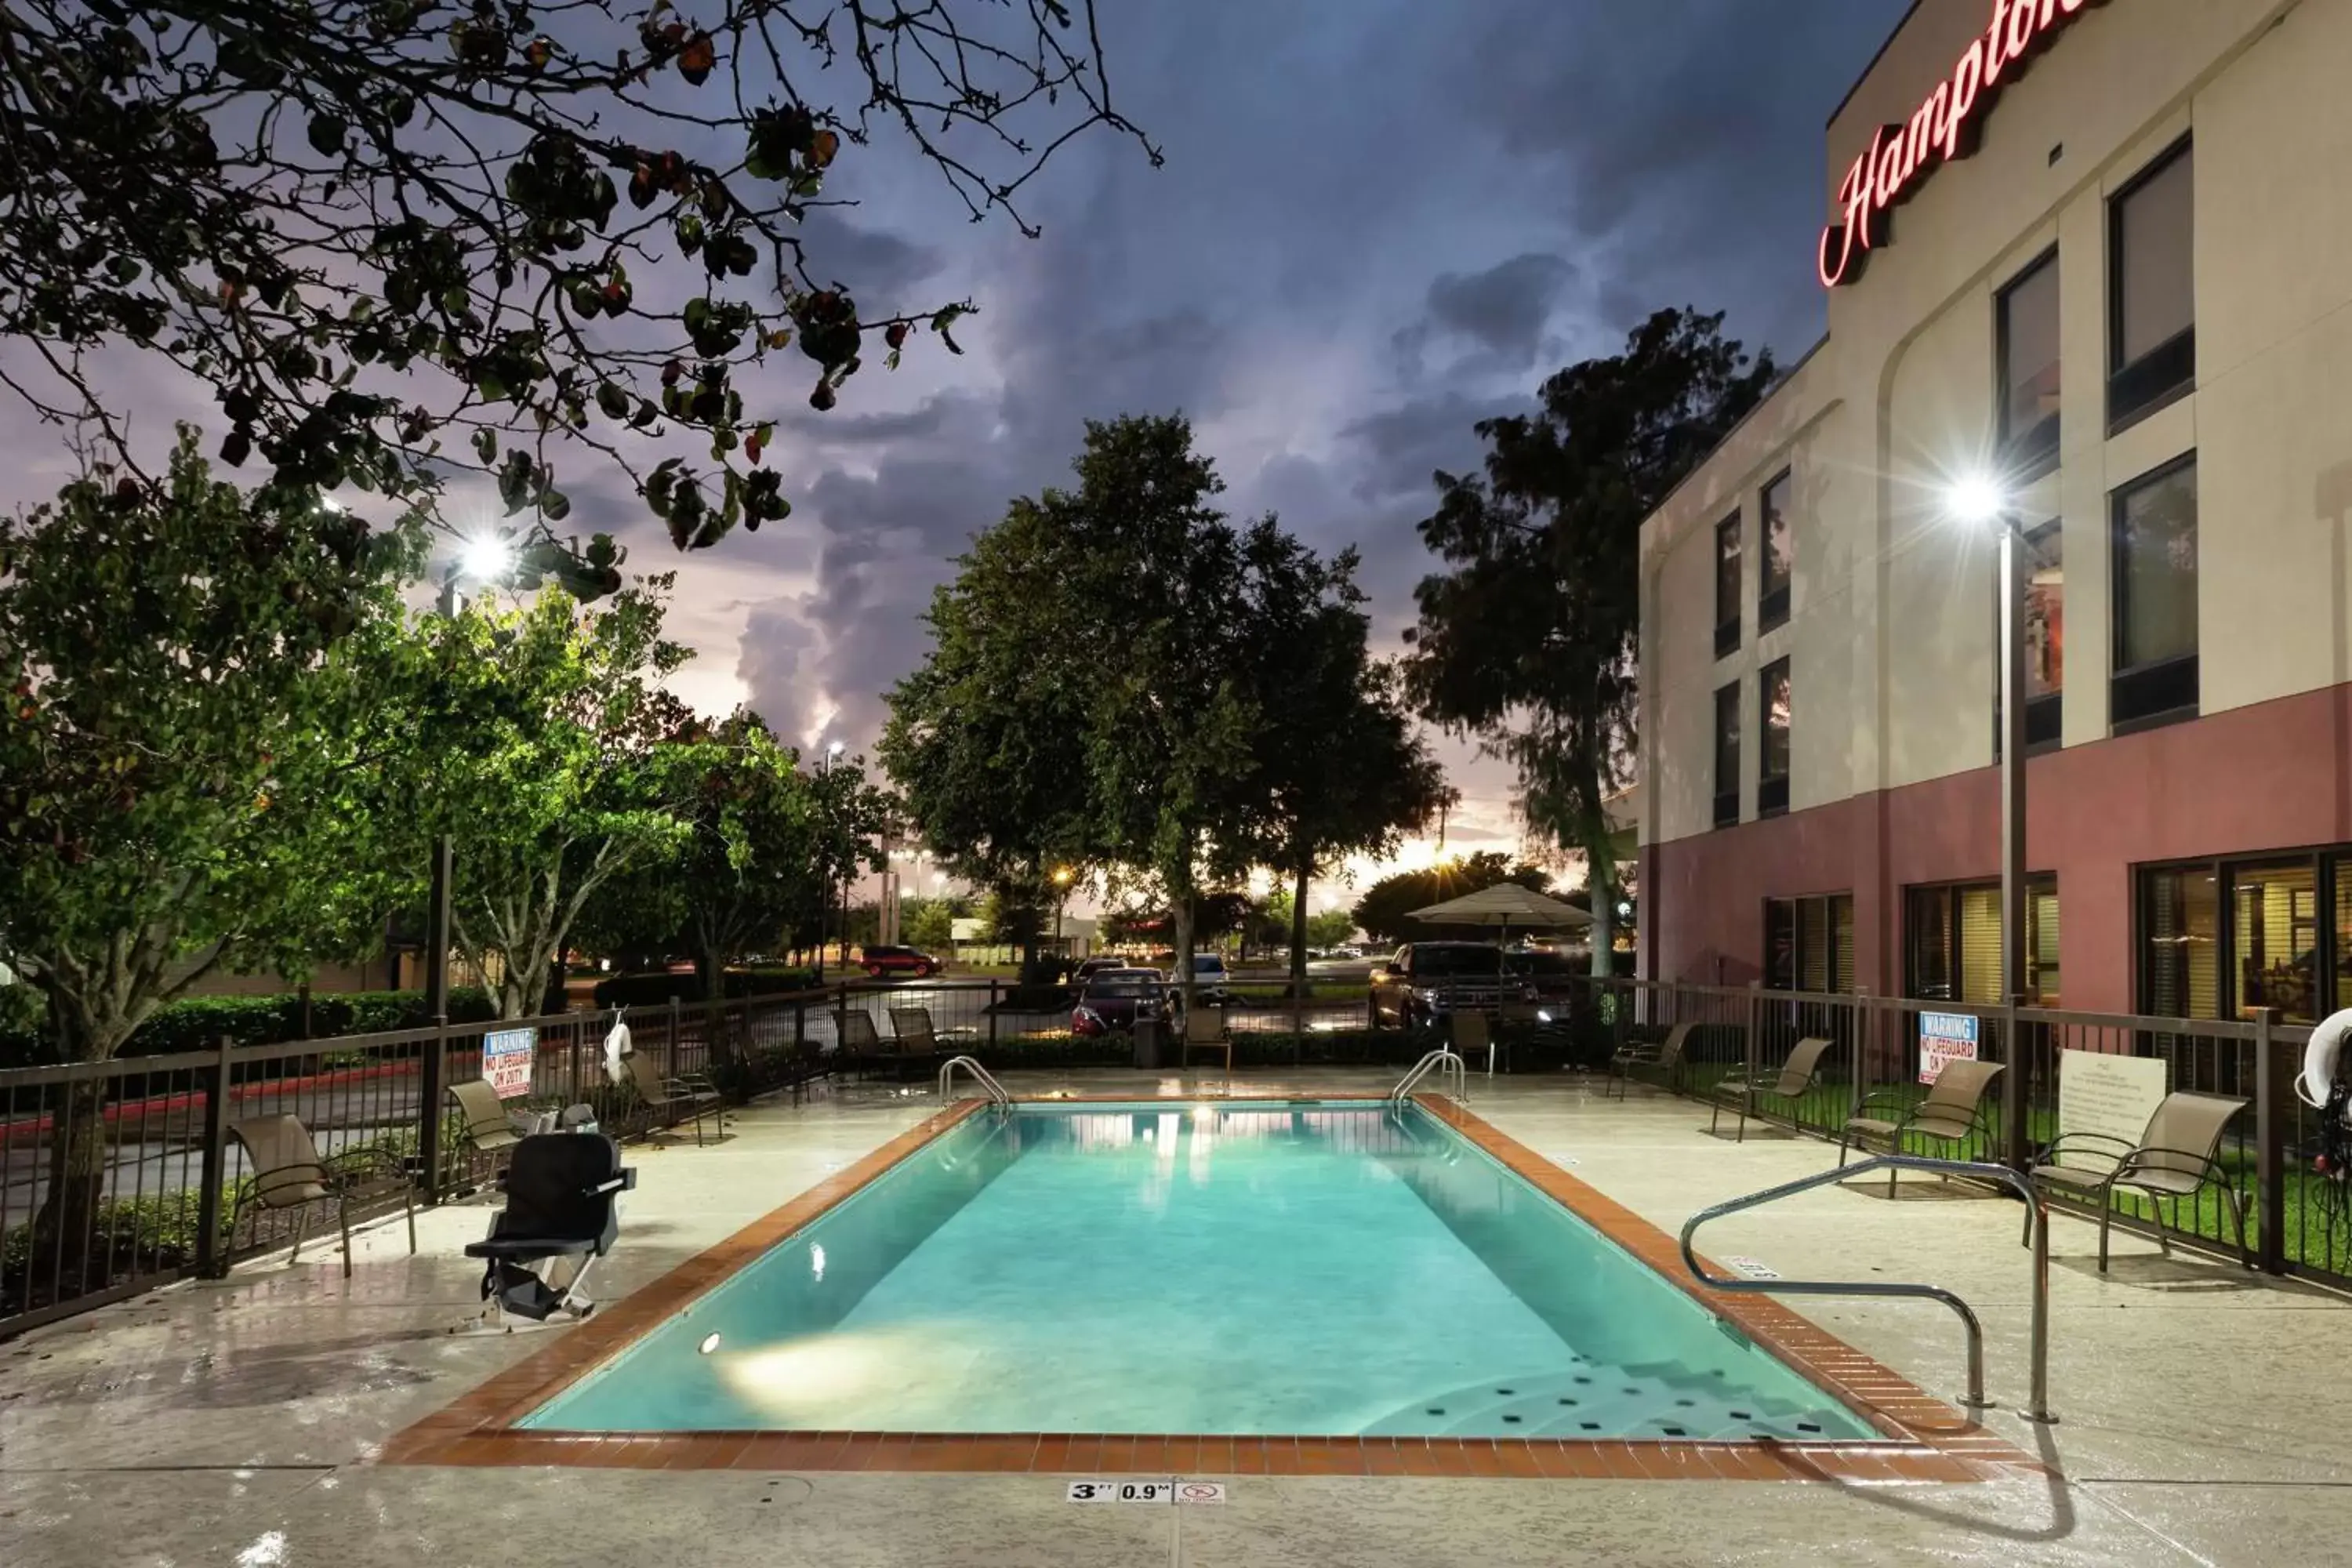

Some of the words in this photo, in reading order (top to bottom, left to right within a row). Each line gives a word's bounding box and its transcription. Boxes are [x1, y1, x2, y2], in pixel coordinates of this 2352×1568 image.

[1925, 1015, 1970, 1039] WARNING
[490, 1030, 531, 1055] WARNING
[1922, 1036, 1929, 1051] NO
[1932, 1038, 1973, 1058] LIFEGUARD
[486, 1056, 496, 1072] NO
[495, 1072, 504, 1087] ON
[506, 1069, 522, 1084] DUTY
[1072, 1484, 1095, 1499] 3
[1122, 1485, 1156, 1499] 0.9
